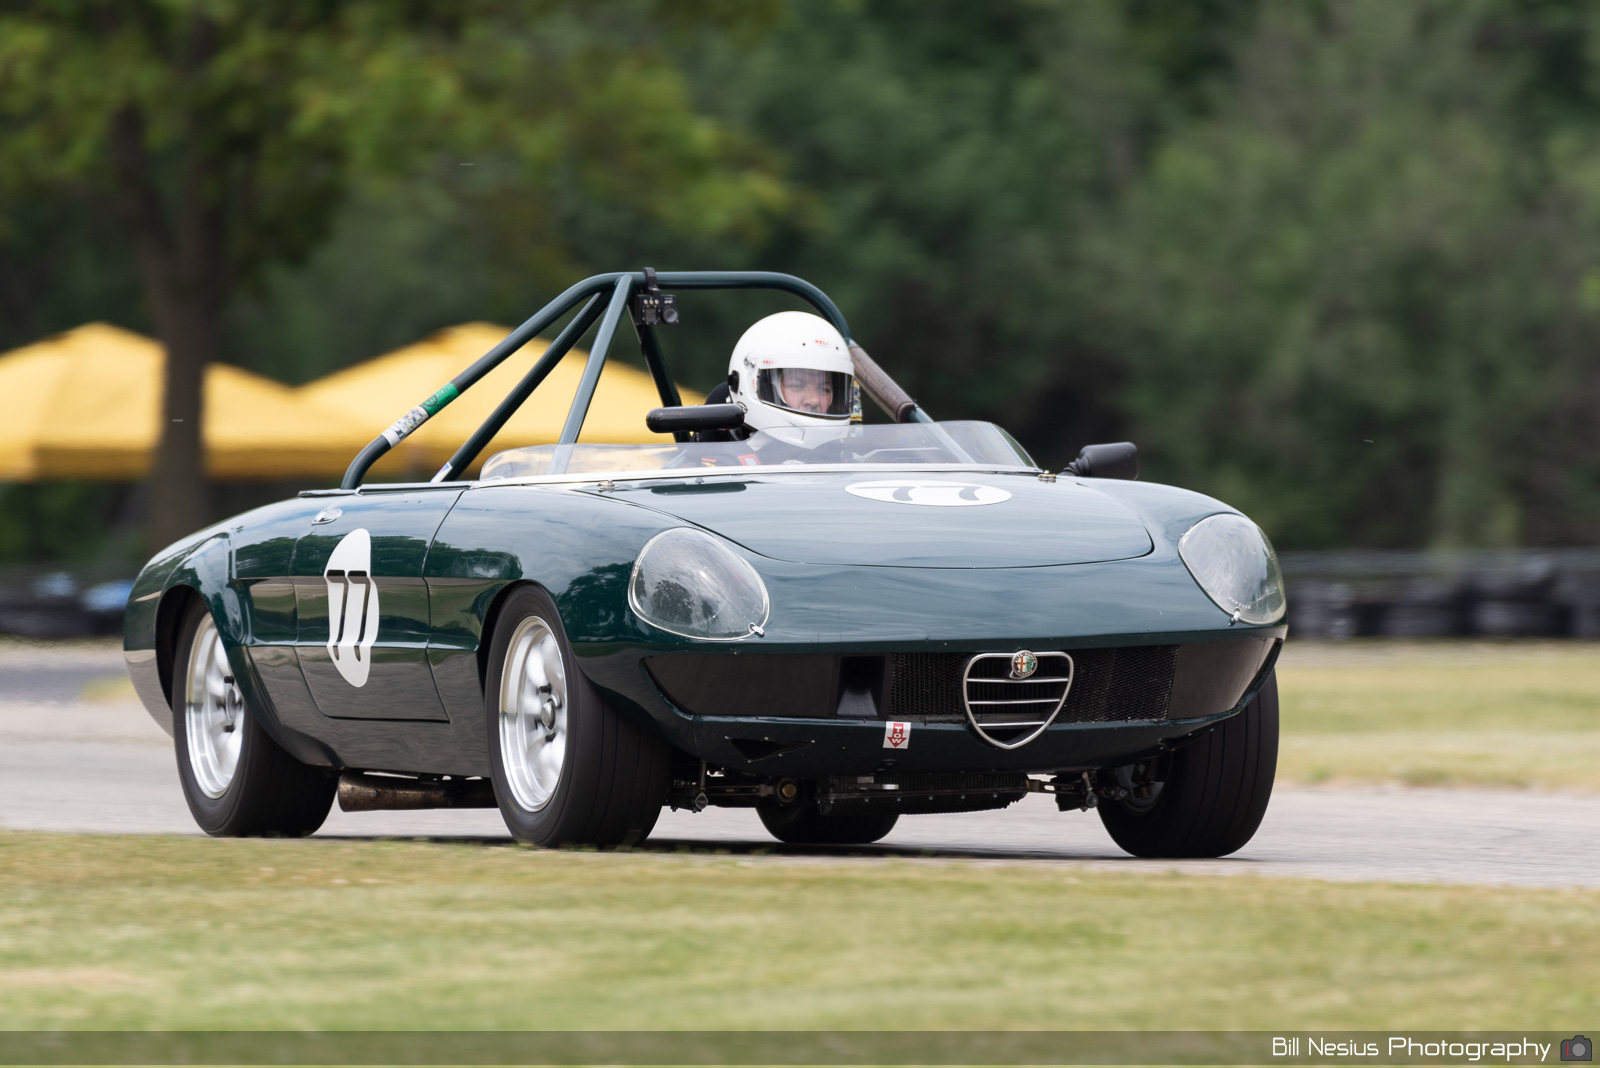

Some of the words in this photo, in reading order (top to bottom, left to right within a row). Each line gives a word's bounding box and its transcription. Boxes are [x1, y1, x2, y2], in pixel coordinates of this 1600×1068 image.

[854, 486, 983, 502] 77
[326, 569, 371, 662] 77
[892, 726, 903, 744] TOW
